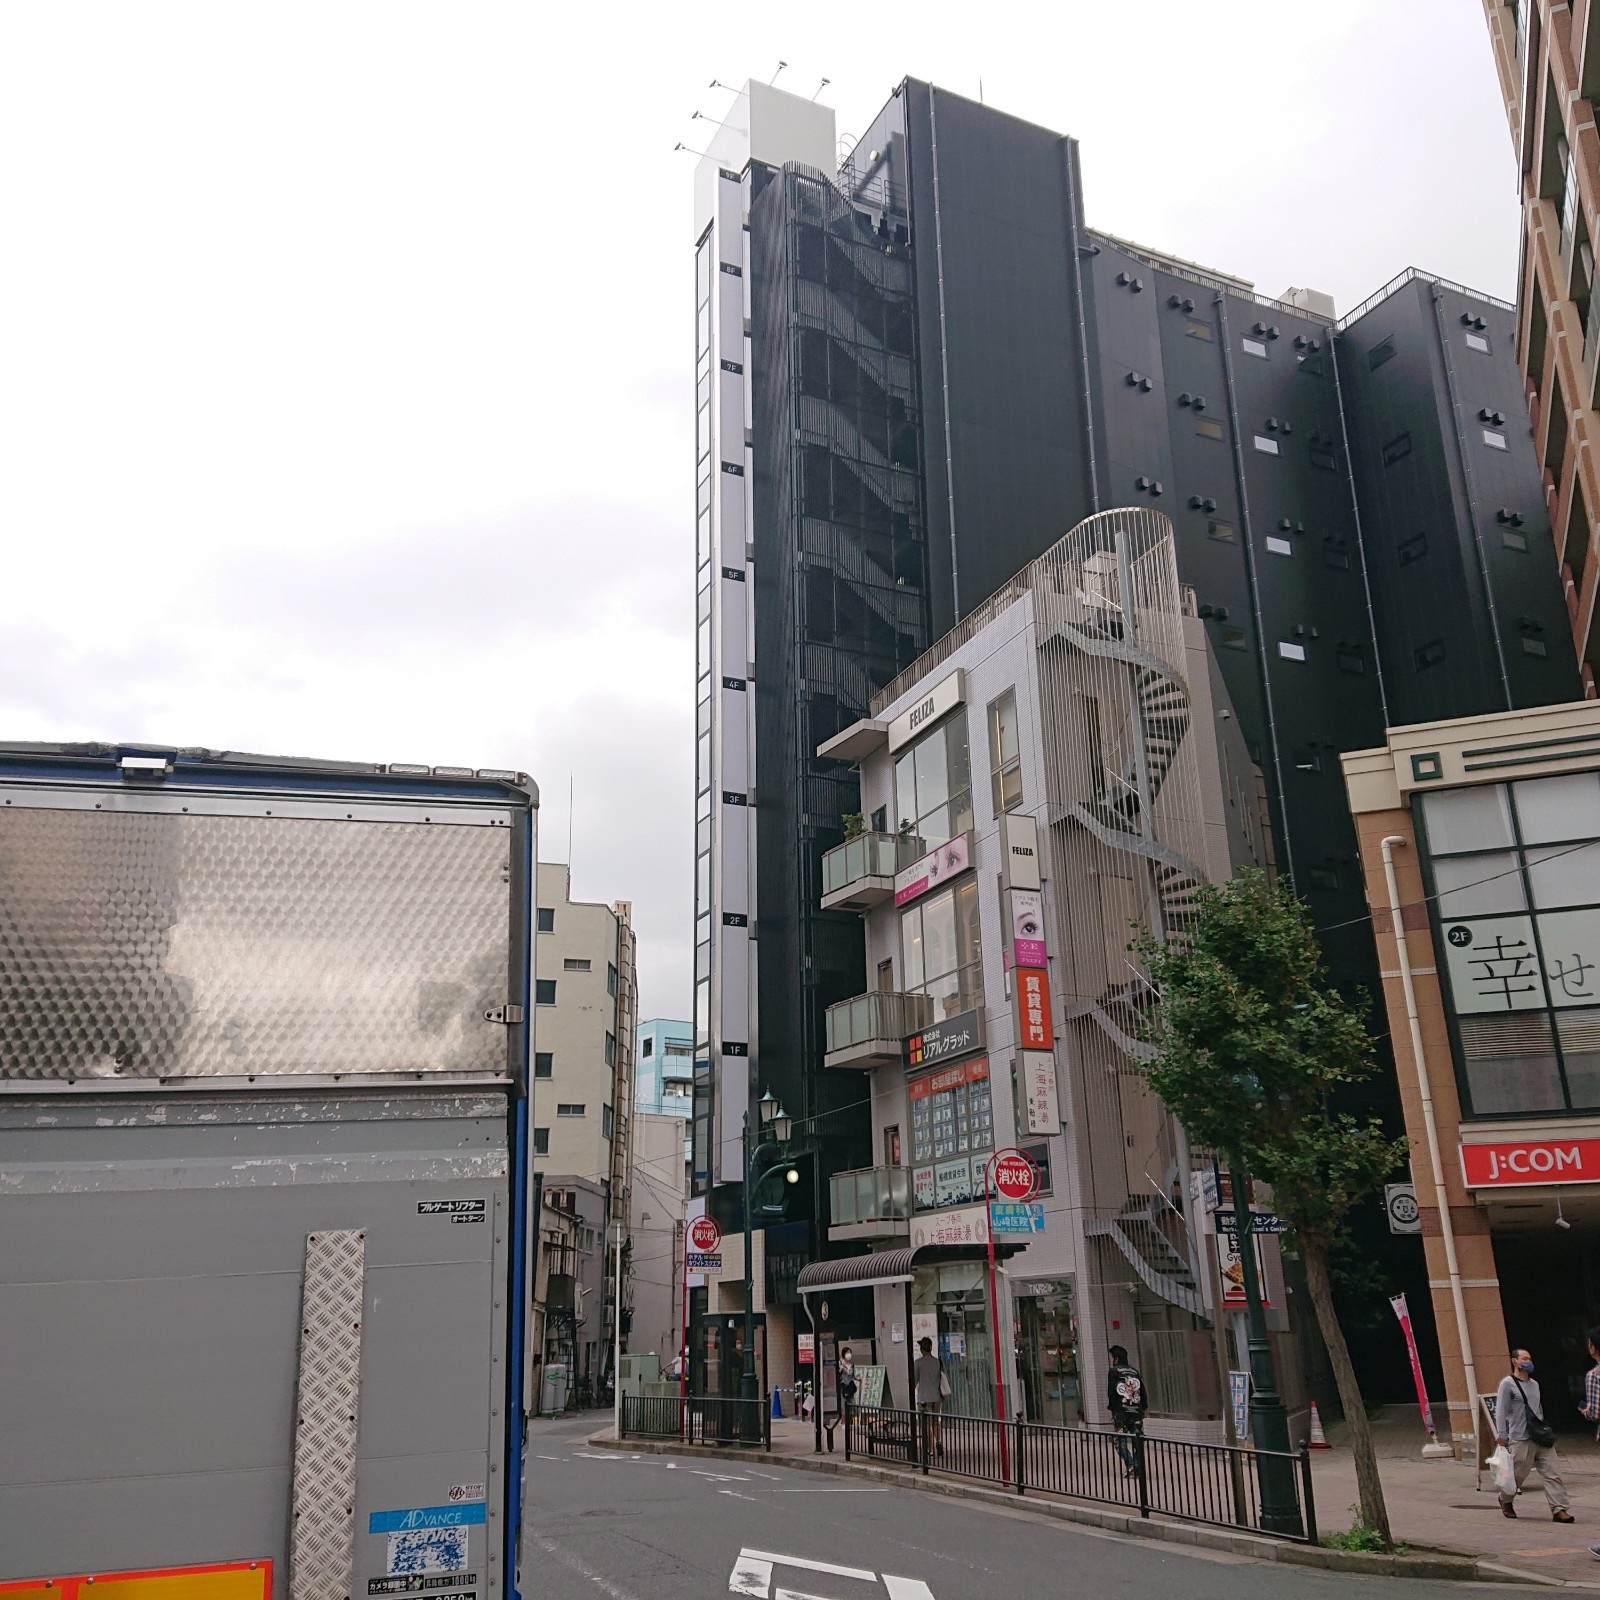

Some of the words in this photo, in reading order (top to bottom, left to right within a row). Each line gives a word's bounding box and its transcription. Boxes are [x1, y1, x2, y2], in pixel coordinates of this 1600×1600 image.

[727, 363, 737, 371] 7F
[728, 464, 738, 474] 6F
[728, 570, 739, 579] 5F
[729, 680, 740, 689] 4F
[909, 696, 935, 730] FELIZA
[729, 795, 740, 804] 3F
[1012, 846, 1034, 857] FELIZA
[730, 916, 740, 925] 2F
[1451, 931, 1468, 943] 2F
[1468, 935, 1596, 1009] 幸せ
[1026, 976, 1044, 1042] 賃貸専門
[922, 1029, 941, 1044] 株式会社
[730, 1046, 740, 1054] 1F
[923, 1030, 970, 1060] リアルグラッド
[1489, 1146, 1583, 1180] J:COM
[998, 1168, 1030, 1186] 消火栓
[996, 1205, 1025, 1216] 皮膚科
[694, 1229, 714, 1242] 消火栓
